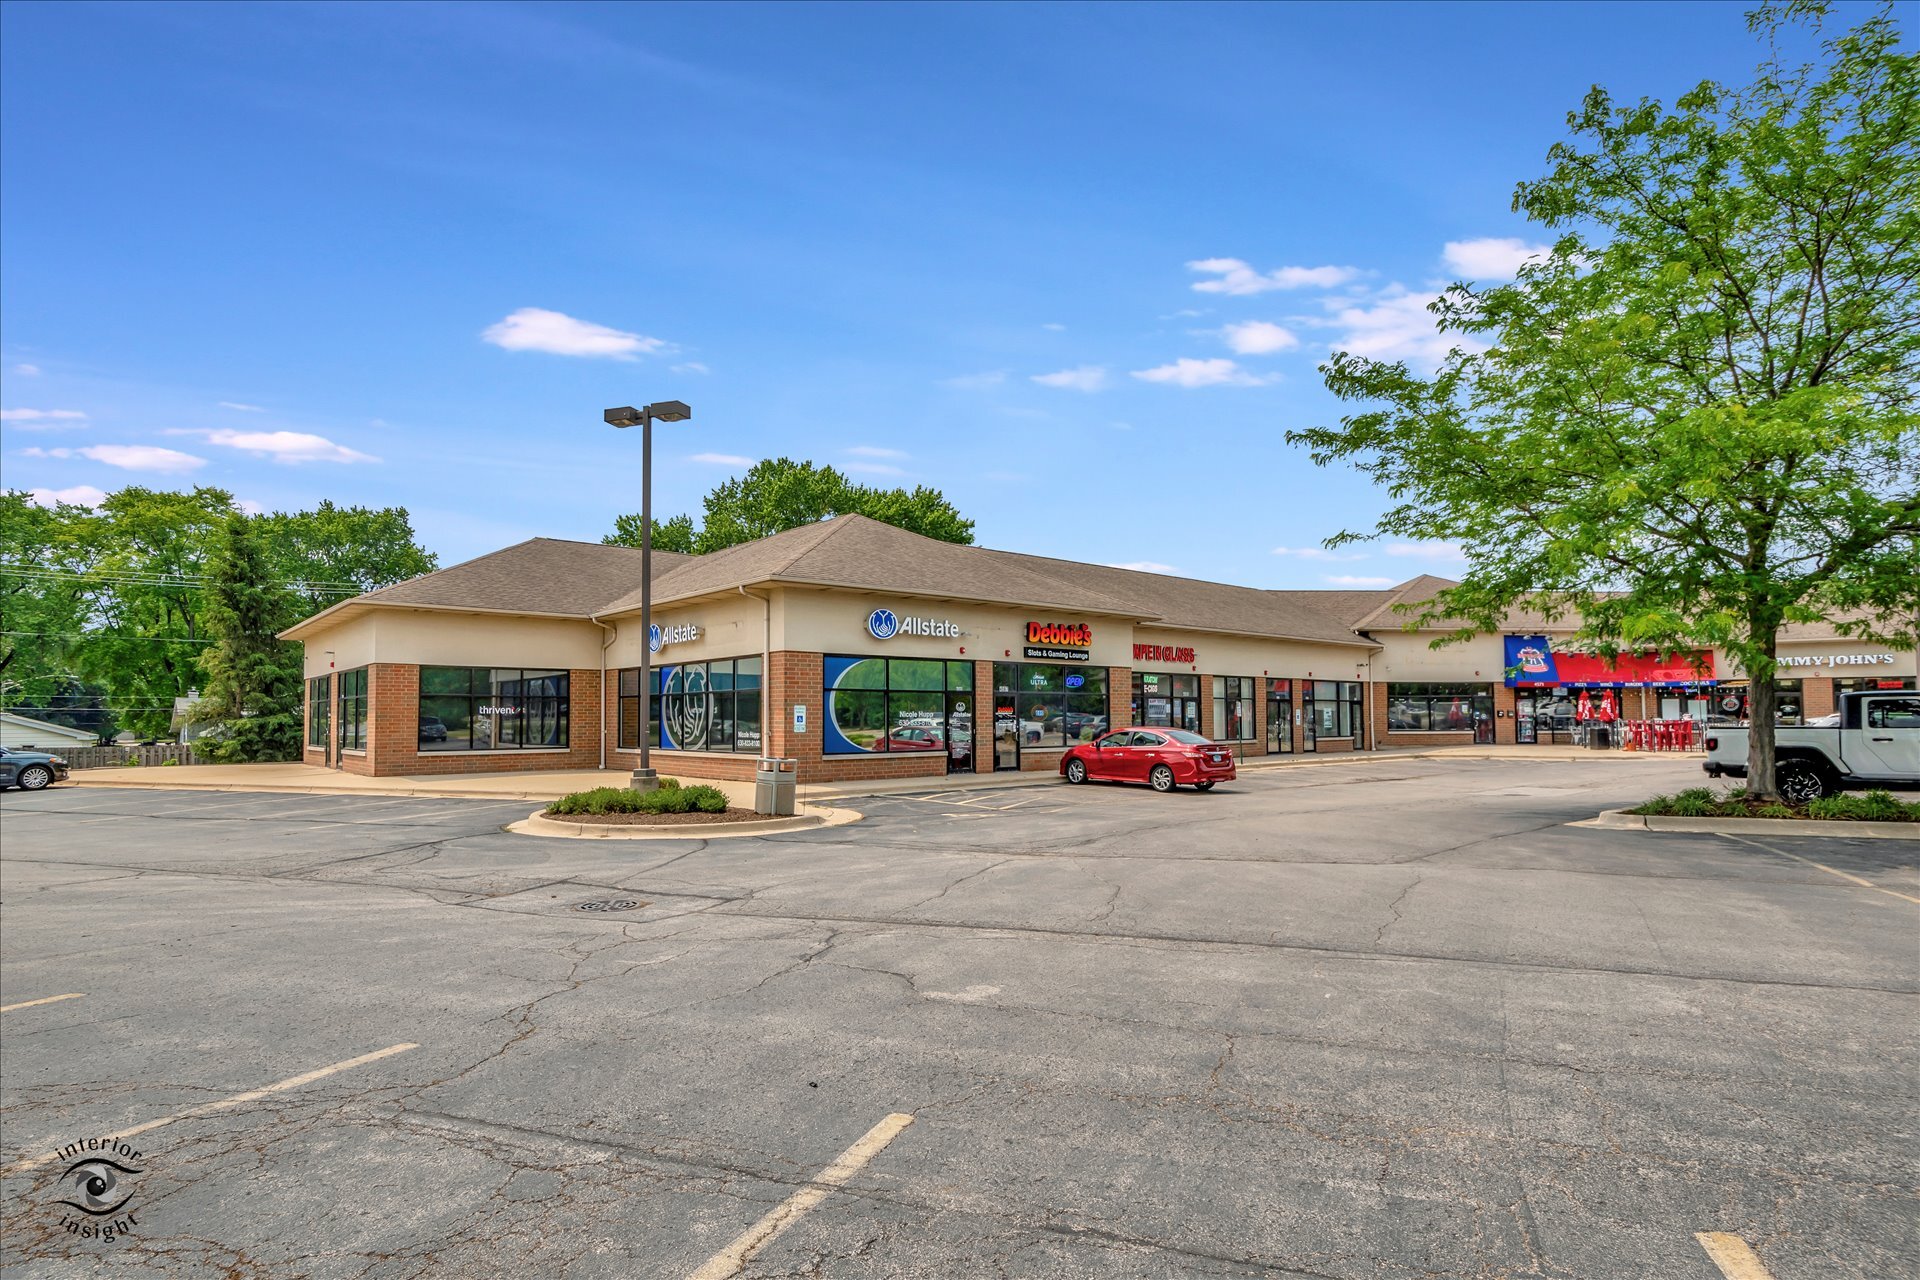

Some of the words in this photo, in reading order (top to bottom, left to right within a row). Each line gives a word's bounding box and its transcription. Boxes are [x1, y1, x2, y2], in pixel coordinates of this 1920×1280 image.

[899, 616, 959, 637] Allstate
[661, 623, 697, 645] Allstate
[1027, 621, 1092, 647] Debbie's
[1027, 649, 1041, 657] Slots
[1048, 651, 1068, 659] Gaming
[1069, 651, 1088, 660] Lounge
[1163, 646, 1195, 663] GLASS
[1775, 656, 1824, 666] MMY
[1828, 654, 1894, 667] JOHN'S
[1066, 677, 1082, 686] OPEN
[479, 705, 515, 714] thrivent
[899, 710, 917, 718] Nicole
[919, 711, 934, 719] Hupp
